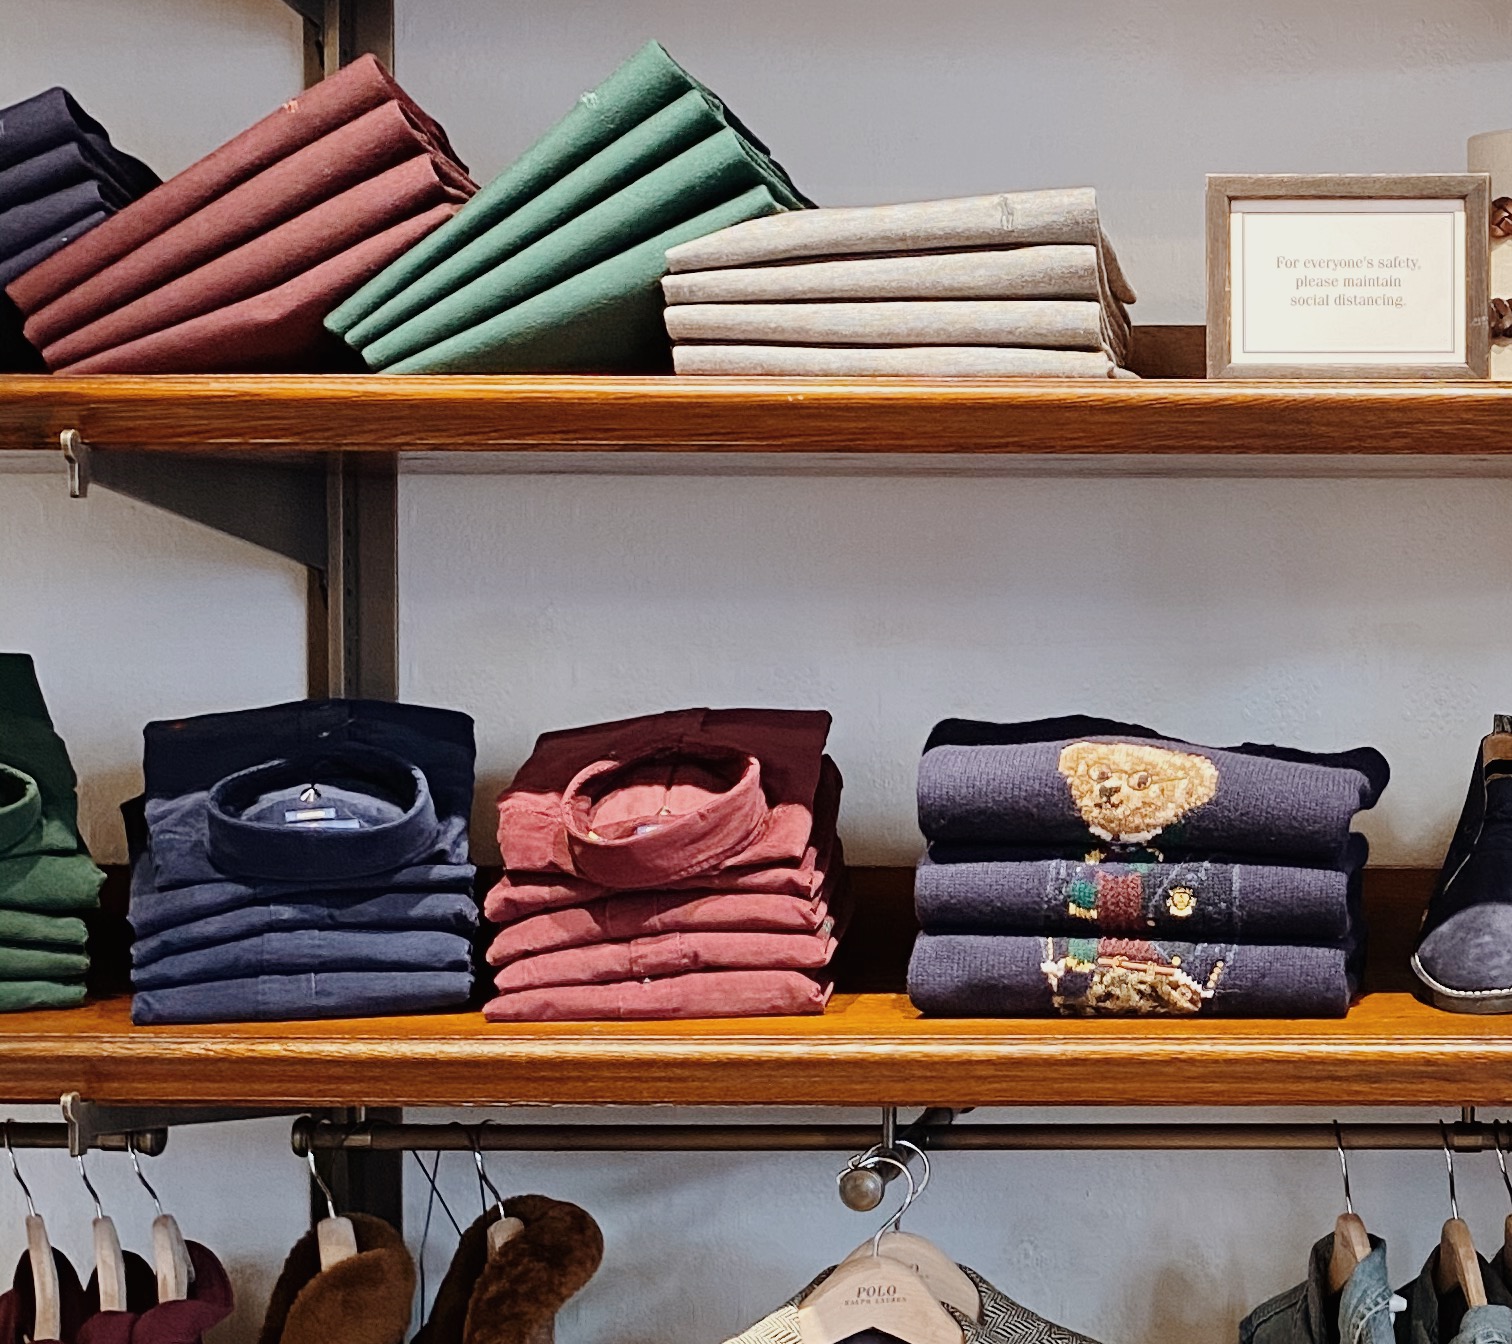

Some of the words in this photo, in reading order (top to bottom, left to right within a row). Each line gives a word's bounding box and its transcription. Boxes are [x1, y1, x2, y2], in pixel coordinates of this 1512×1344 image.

[1276, 256, 1300, 269] For
[1303, 256, 1374, 271] everyone's
[1377, 256, 1421, 271] safety,
[1295, 275, 1339, 290] please
[1343, 275, 1402, 288] maintain
[1290, 293, 1330, 306] social
[1333, 293, 1407, 308] distancing.
[857, 1284, 897, 1298] POLO
